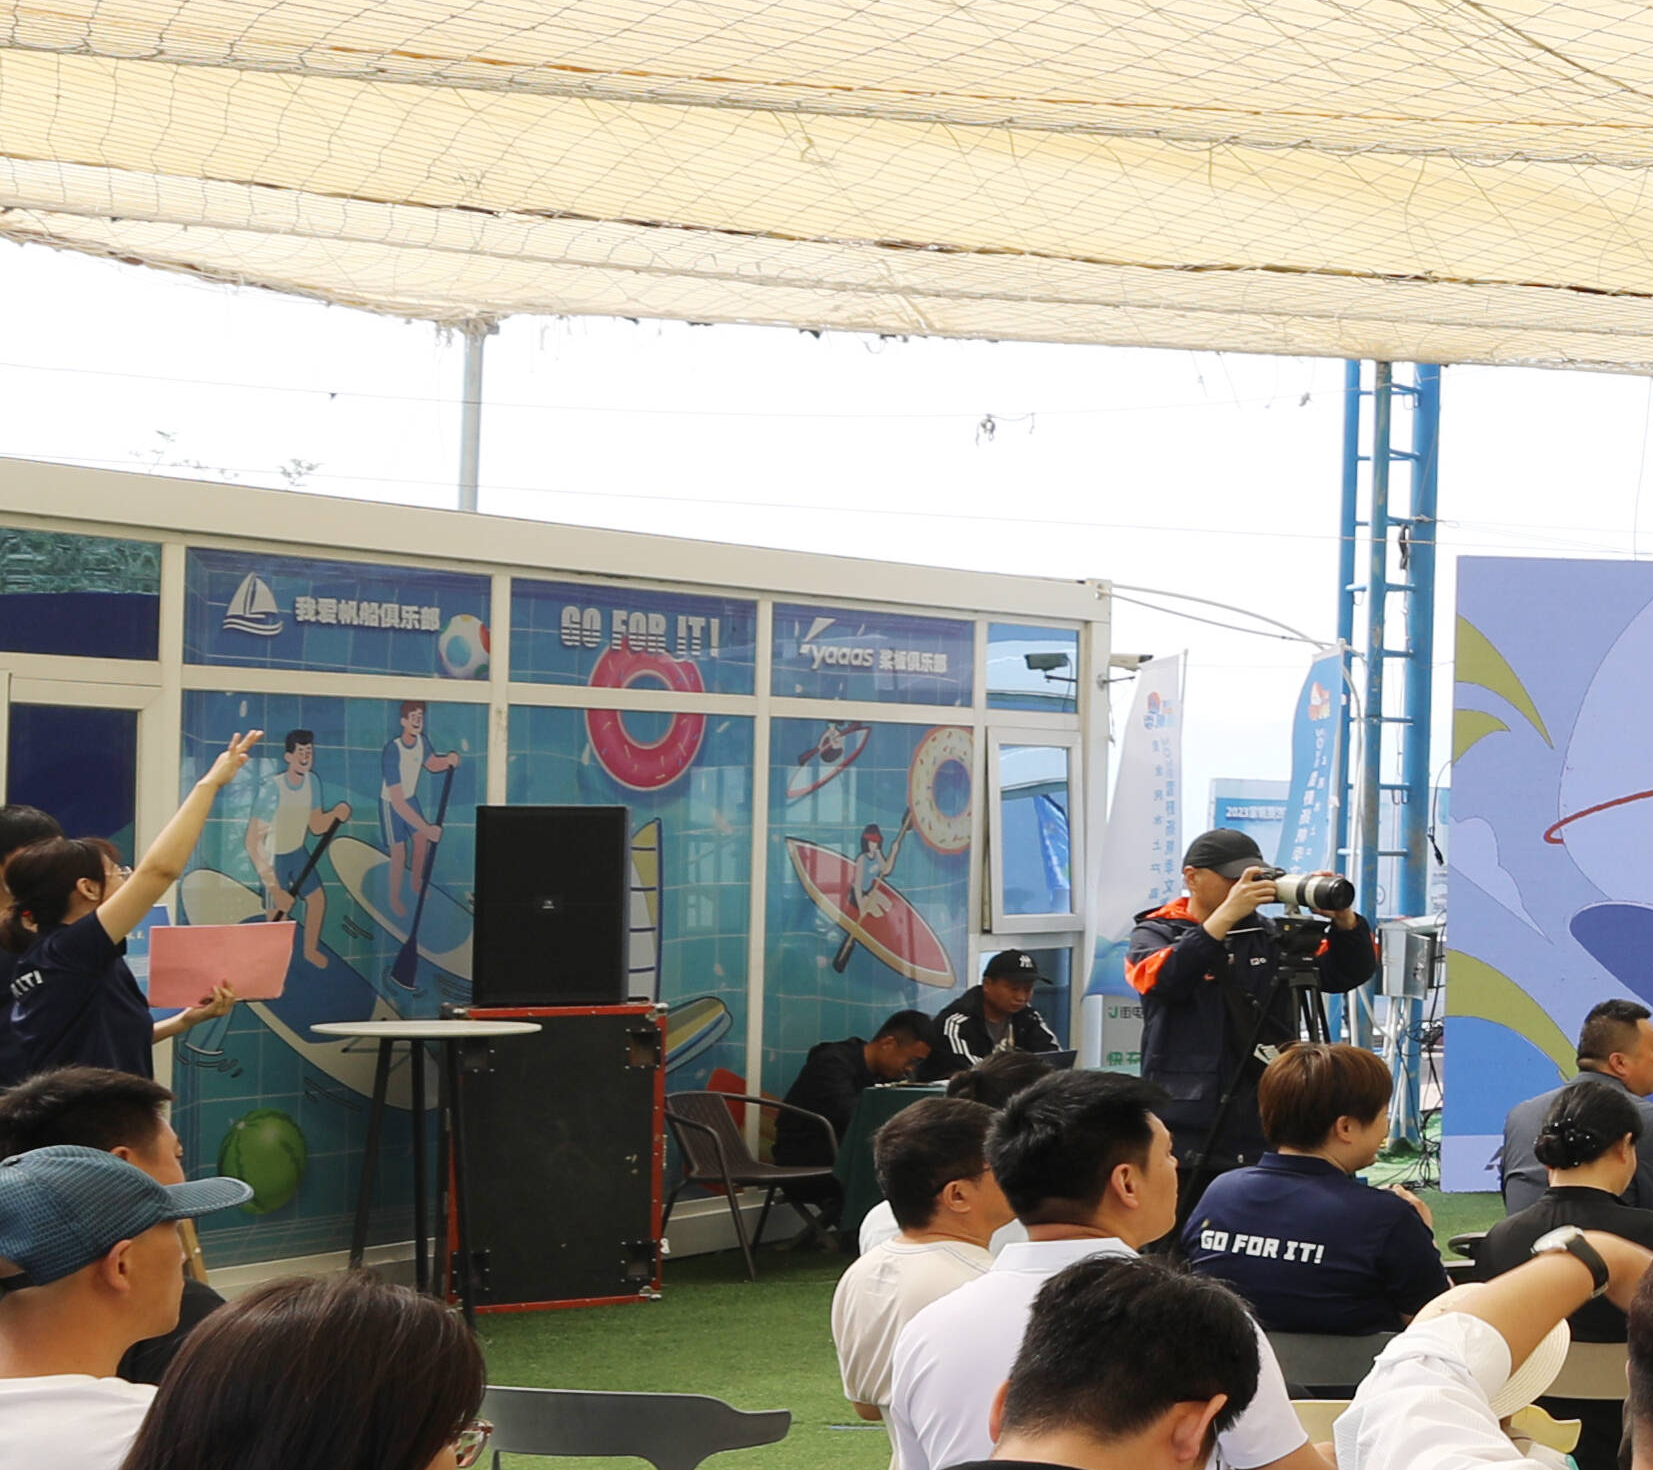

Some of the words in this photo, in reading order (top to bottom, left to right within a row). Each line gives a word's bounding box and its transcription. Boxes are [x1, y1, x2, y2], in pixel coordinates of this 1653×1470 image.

[294, 596, 440, 631] 我爱帆船俱乐部
[560, 606, 600, 648] GO
[611, 610, 667, 653] FOR
[676, 614, 720, 658] IT!
[810, 643, 874, 671] yaaas
[1201, 1229, 1229, 1252] GO
[1231, 1233, 1280, 1259] FOR
[1283, 1240, 1325, 1264] IT!
